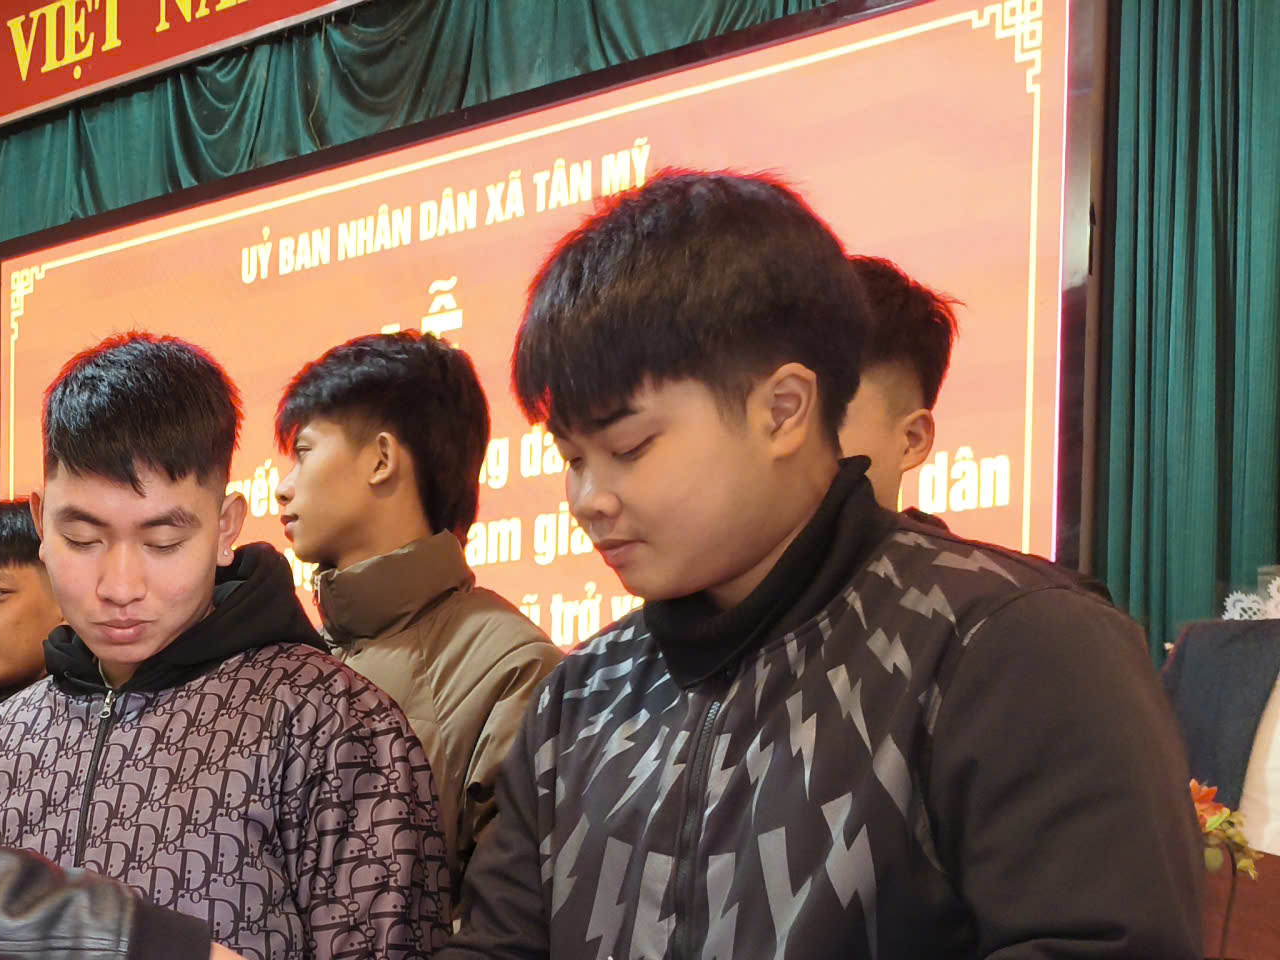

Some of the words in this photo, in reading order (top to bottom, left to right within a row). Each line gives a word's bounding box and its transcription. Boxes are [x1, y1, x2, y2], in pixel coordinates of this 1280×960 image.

[7, 0, 122, 82] VIỆT
[241, 226, 273, 284] UỶ
[278, 227, 331, 275] BAN
[337, 204, 412, 260] NHÂN
[420, 187, 477, 240] DÂN
[485, 169, 524, 225] XÃ
[533, 158, 592, 212] TÂN
[601, 137, 651, 196] MỸ
[465, 517, 521, 567] am
[918, 446, 1010, 514] dân
[550, 581, 602, 647] trở
